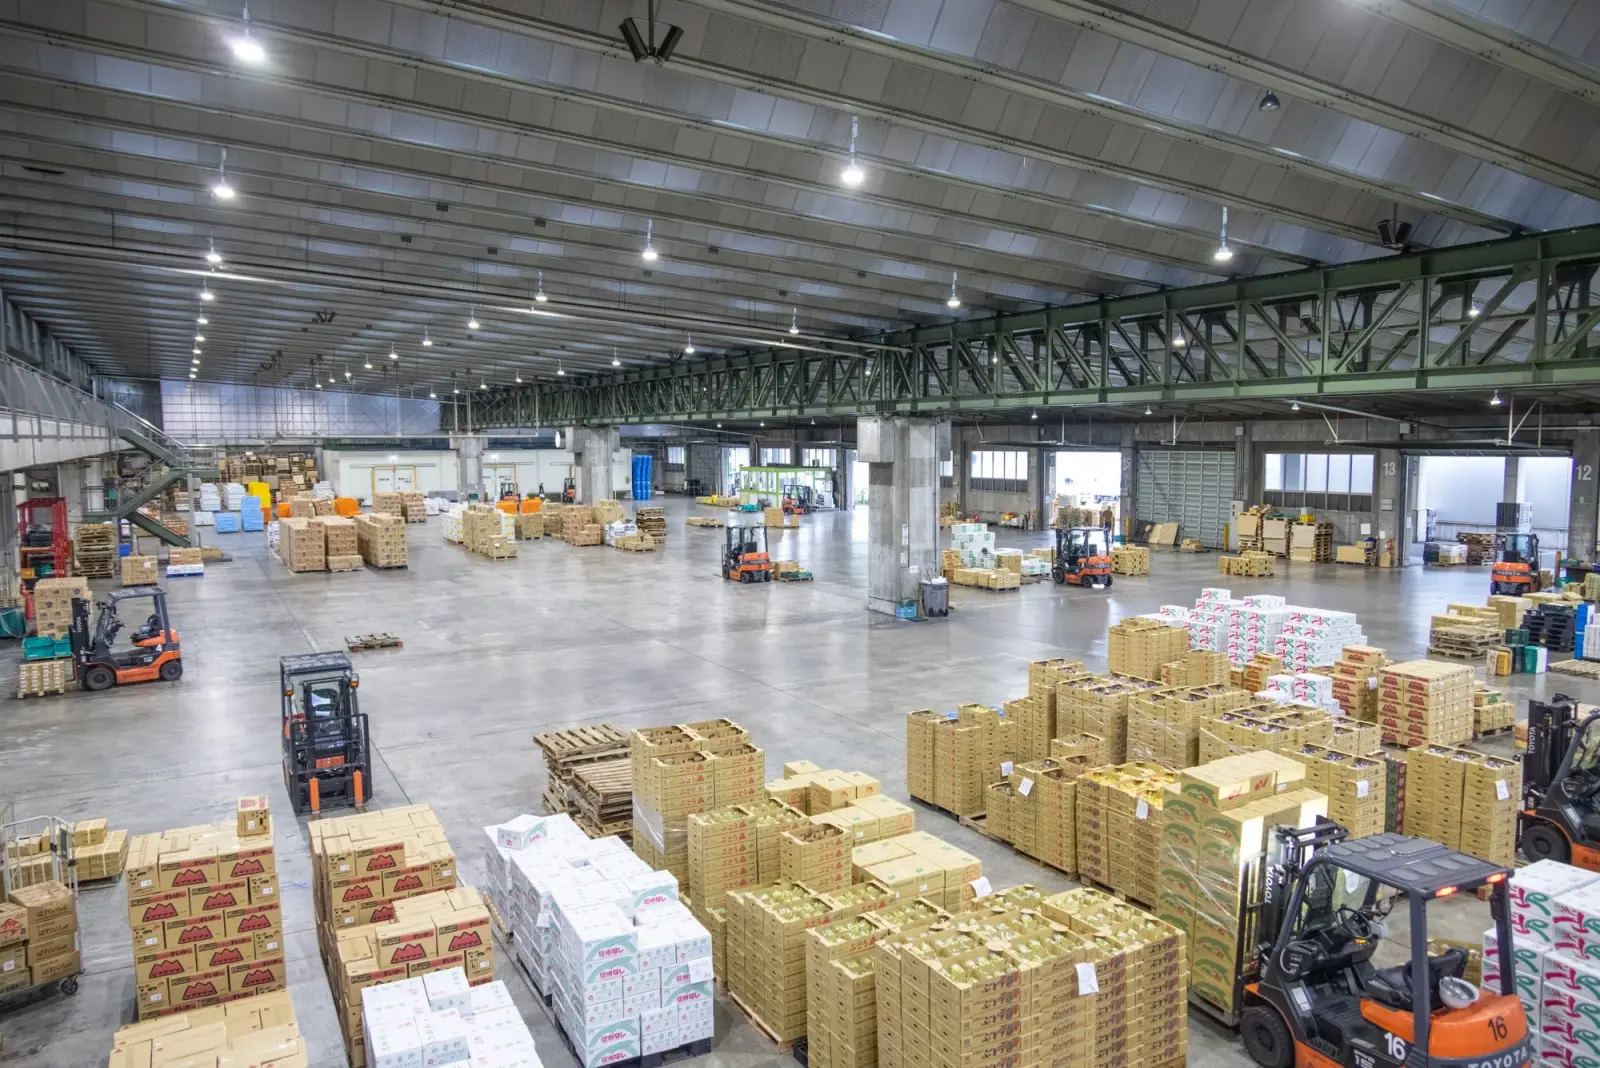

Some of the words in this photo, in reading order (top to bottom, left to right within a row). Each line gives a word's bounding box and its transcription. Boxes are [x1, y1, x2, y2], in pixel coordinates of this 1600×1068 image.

[1382, 462, 1396, 476] 13
[1576, 465, 1592, 480] 12
[156, 644, 162, 652] 4
[1528, 726, 1536, 754] TOYOTA
[1264, 866, 1275, 904] TOYOTA
[1488, 1015, 1508, 1041] 16
[1384, 1032, 1406, 1061] 16
